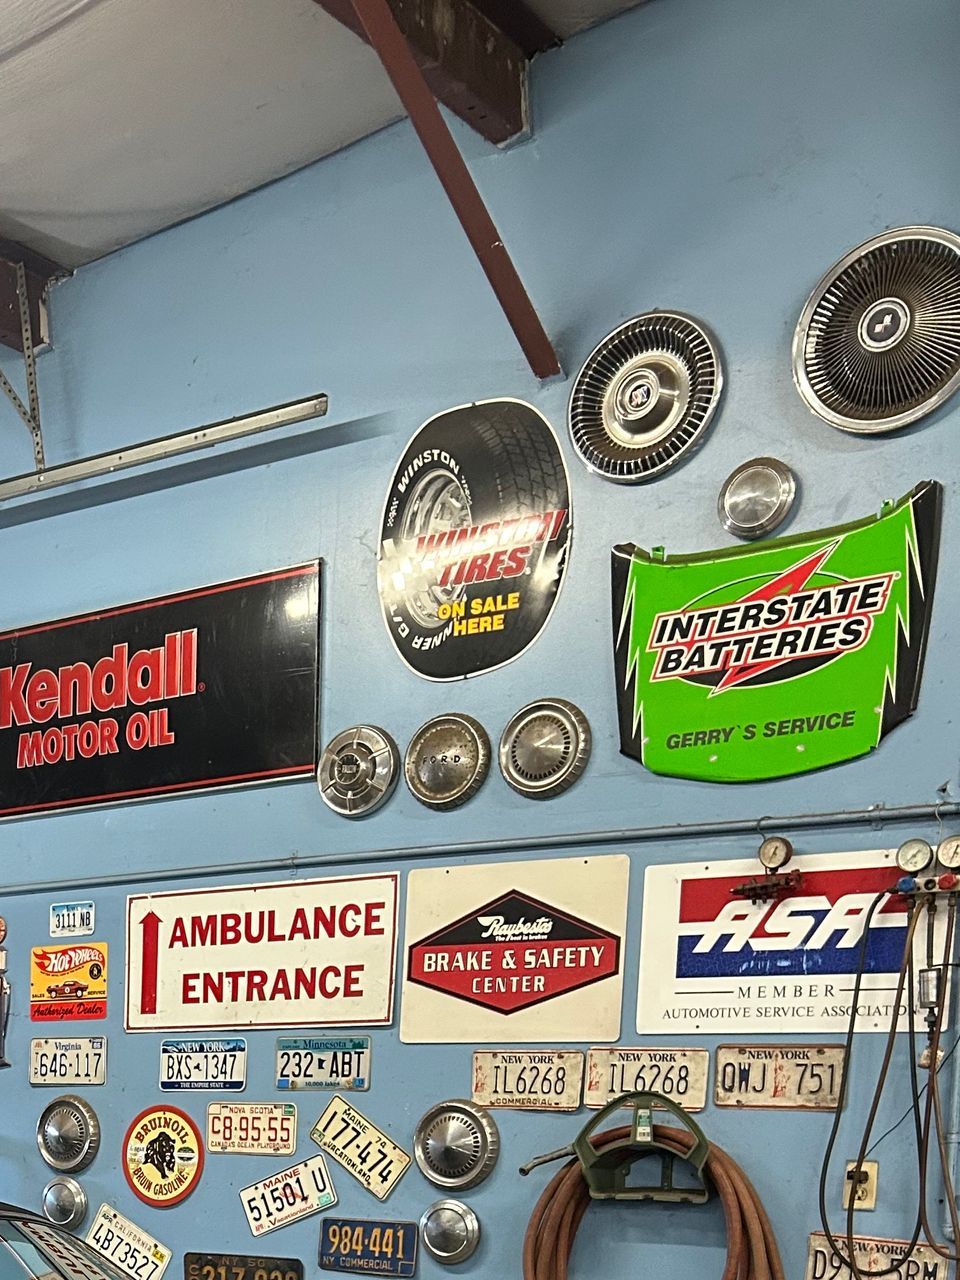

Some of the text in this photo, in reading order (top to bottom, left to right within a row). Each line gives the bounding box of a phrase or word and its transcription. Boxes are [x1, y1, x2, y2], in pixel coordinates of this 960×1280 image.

[397, 448, 460, 493] WINSTON
[439, 545, 530, 588] TIRES
[437, 592, 520, 620] ON SALE
[654, 580, 885, 644] INTERSTATE
[453, 613, 505, 637] HERE
[658, 617, 864, 677] BATTERIES
[762, 710, 857, 738] SERVICE
[16, 708, 175, 770] MOTOR OIL
[422, 755, 461, 764] FORD
[55, 911, 91, 929] 3111 NB
[168, 902, 385, 949] AMBULANCE
[477, 915, 553, 938] Raybestos
[423, 945, 605, 973] BRAKE & SAFETY
[182, 965, 365, 1004] ENTRANCE
[471, 975, 545, 993] CENTER
[738, 984, 836, 999] MEMBER
[662, 1006, 751, 1020] AUTOMOTIVE
[756, 1005, 815, 1018] SERVICE
[55, 1042, 81, 1052] Virginia
[180, 1043, 225, 1053] NEW YORK
[303, 1040, 347, 1049] Minnesota
[747, 1050, 810, 1060] NEW YORK
[167, 1054, 237, 1080] BXS 1347
[280, 1051, 365, 1078] 232 ABT
[501, 1054, 554, 1064] NEW YORK
[618, 1053, 676, 1063] NEW YORK
[493, 1065, 566, 1095] IL6268
[795, 1063, 836, 1095] 751
[229, 1106, 274, 1114] NOVA SCOTIA
[343, 1109, 370, 1134] MAINE
[327, 1141, 371, 1186] VACATIONLAND
[133, 1167, 188, 1196] BRUIN GASOLINE
[262, 1168, 301, 1190] MAINE
[247, 1167, 326, 1222] 51501 U
[101, 1213, 152, 1251] APR CALIFORNIA
[840, 1241, 908, 1256] NEW YORK
[222, 1257, 237, 1266] NY
[323, 1256, 393, 1271] NY COMMERCIAL
